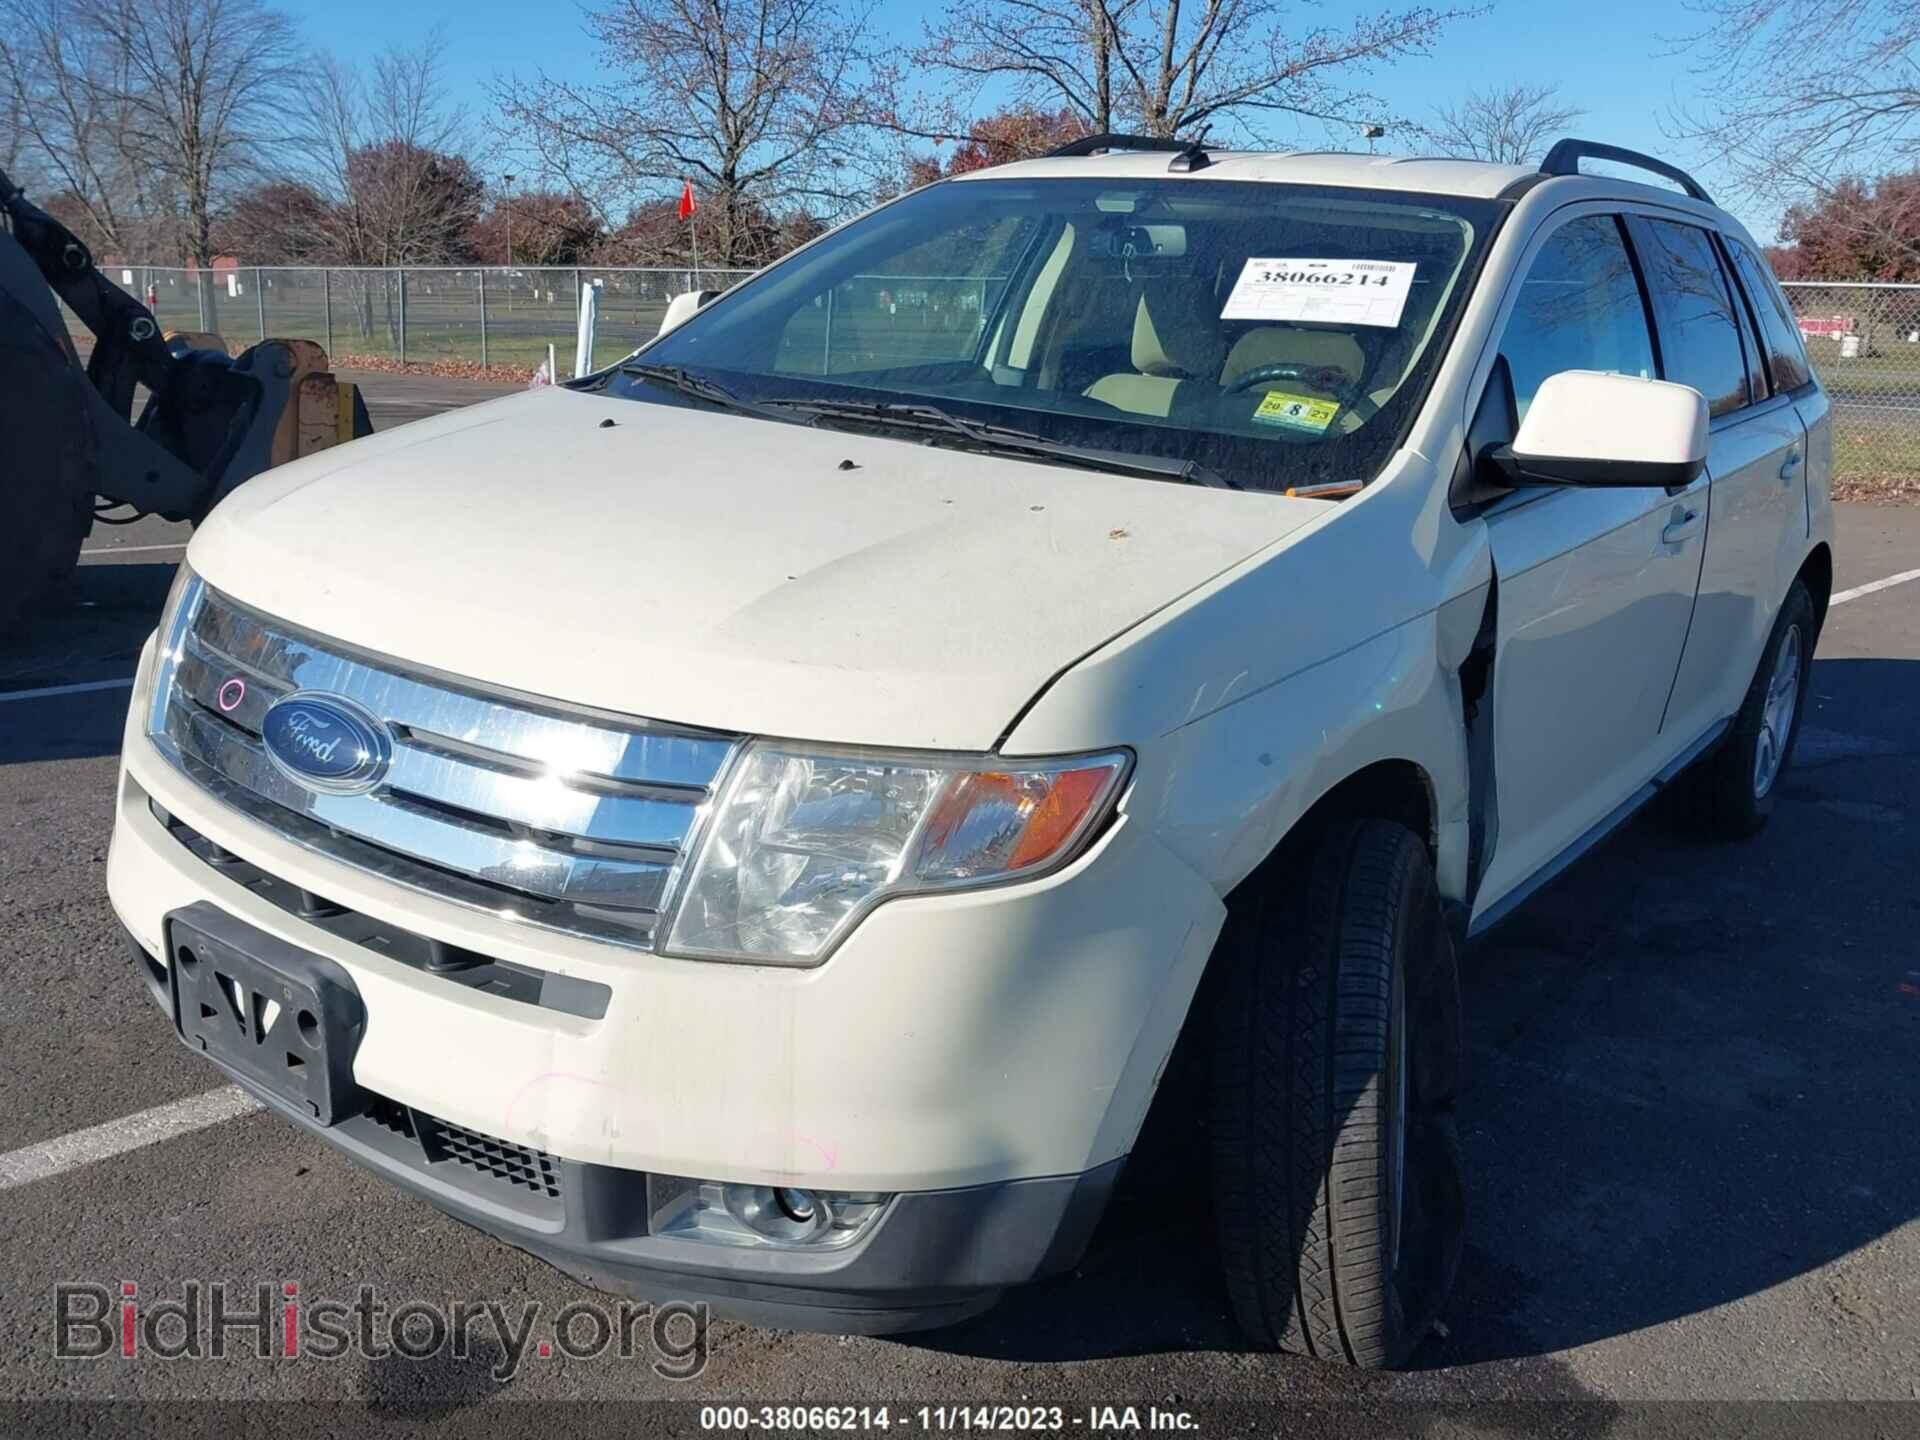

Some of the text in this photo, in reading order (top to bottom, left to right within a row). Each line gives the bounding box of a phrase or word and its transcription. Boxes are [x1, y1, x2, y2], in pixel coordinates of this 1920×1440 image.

[1256, 271, 1389, 287] 38066214
[1263, 402, 1281, 411] 20
[1290, 404, 1303, 416] 8
[287, 710, 342, 763] Ford
